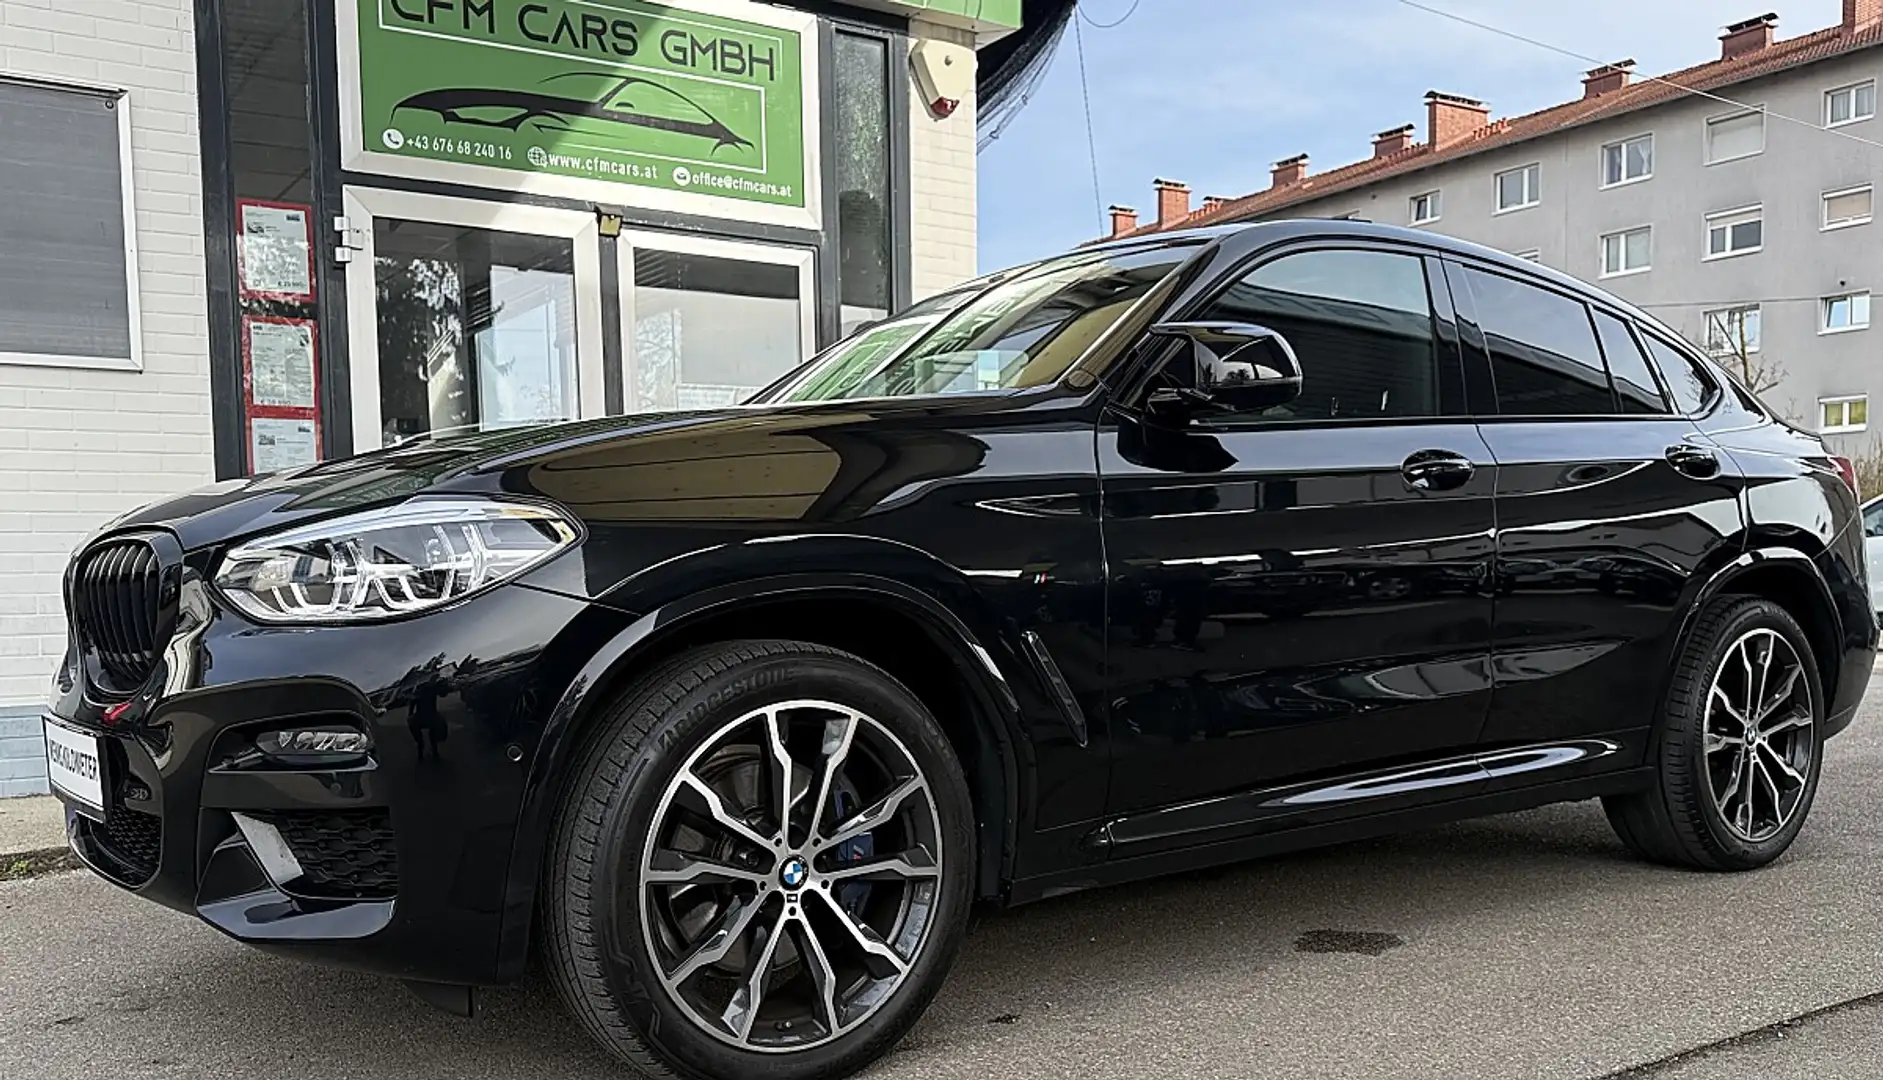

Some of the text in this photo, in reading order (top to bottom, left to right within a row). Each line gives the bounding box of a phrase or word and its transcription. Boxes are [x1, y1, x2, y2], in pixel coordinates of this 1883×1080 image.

[391, 0, 774, 81] CFM CARS GMBH
[406, 135, 512, 160] +43 676 68 240 16
[548, 154, 658, 179] www.cfmcars.at
[692, 172, 792, 197] office@cfmcars.at
